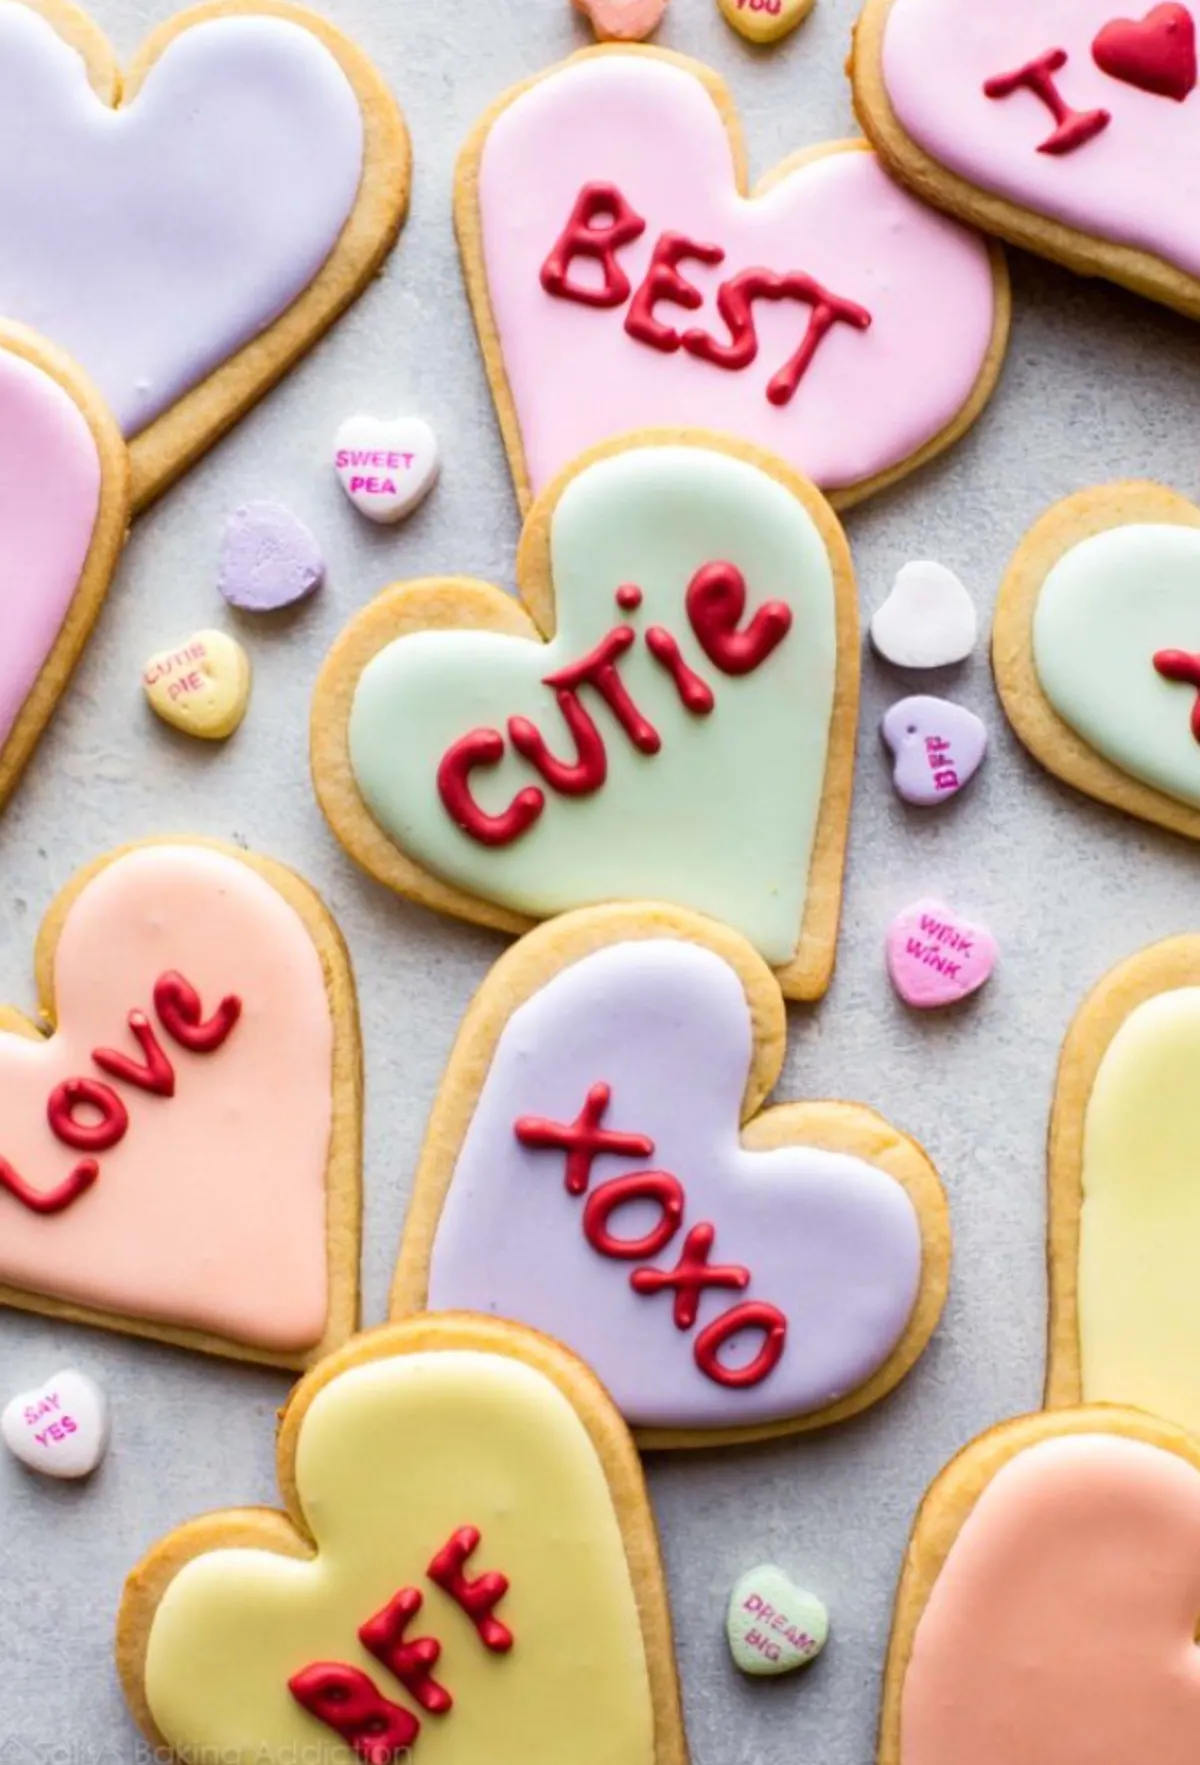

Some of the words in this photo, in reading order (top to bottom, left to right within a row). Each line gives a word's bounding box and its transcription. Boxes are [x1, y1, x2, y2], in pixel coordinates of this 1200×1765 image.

[982, 47, 1111, 157] I
[539, 181, 873, 409] BEST
[335, 449, 415, 470] SWEET
[349, 476, 397, 495] PEA
[144, 643, 206, 686] CUTIE
[167, 671, 204, 702] PIE
[514, 1082, 788, 1388] XOXO
[23, 1391, 61, 1426] SAY
[33, 1415, 78, 1449] YES
[743, 1592, 817, 1656] DREAM
[286, 1523, 514, 1765] BFF
[744, 1627, 783, 1663] BIG
